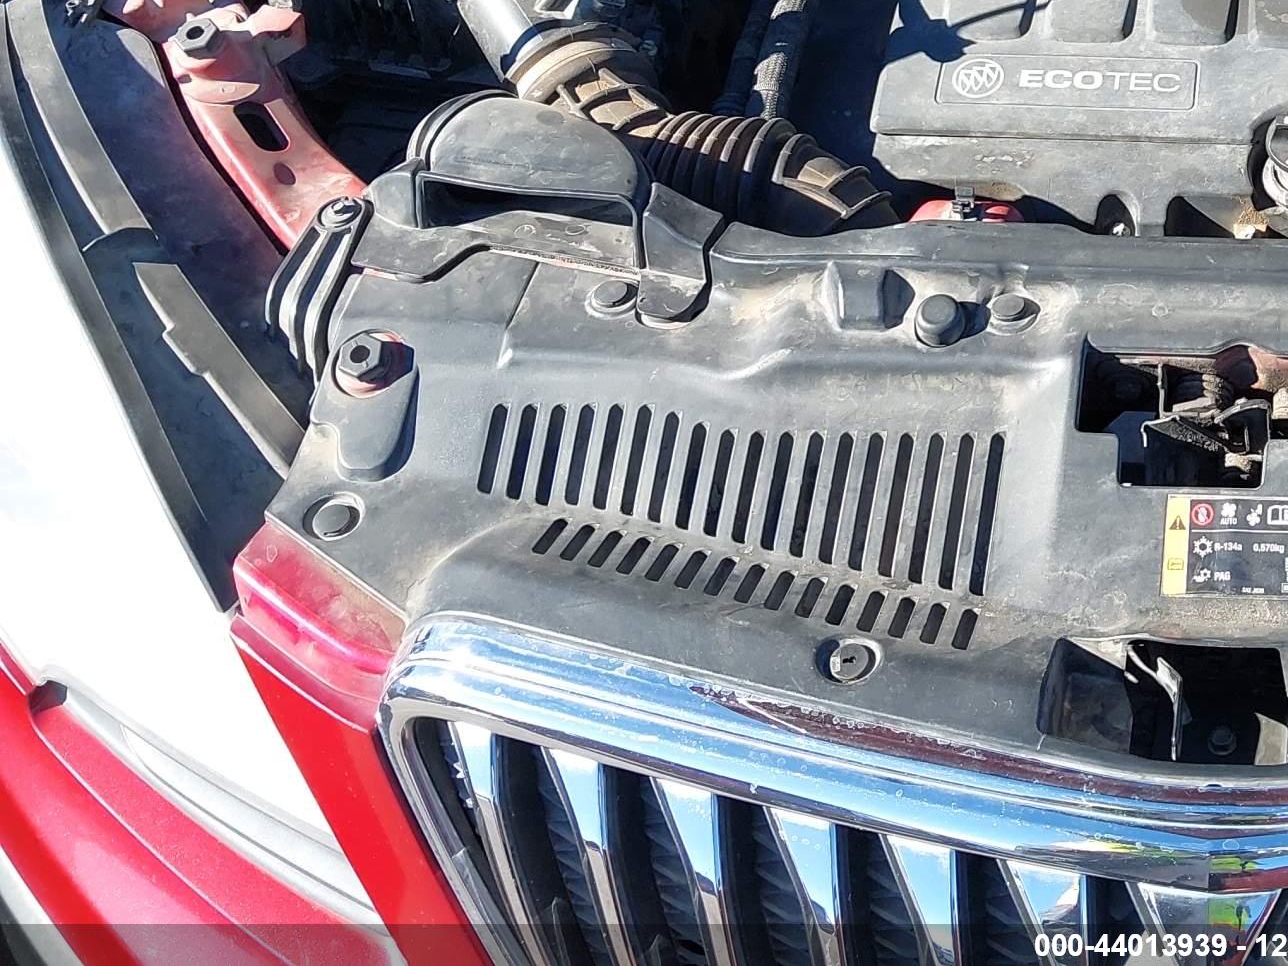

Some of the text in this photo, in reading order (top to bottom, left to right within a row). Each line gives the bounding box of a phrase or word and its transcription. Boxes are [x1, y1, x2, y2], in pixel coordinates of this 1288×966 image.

[1018, 68, 1181, 93] ECOTEC
[1219, 517, 1238, 526] AUTO
[1213, 541, 1243, 552] R-134a
[1213, 570, 1232, 582] PAG
